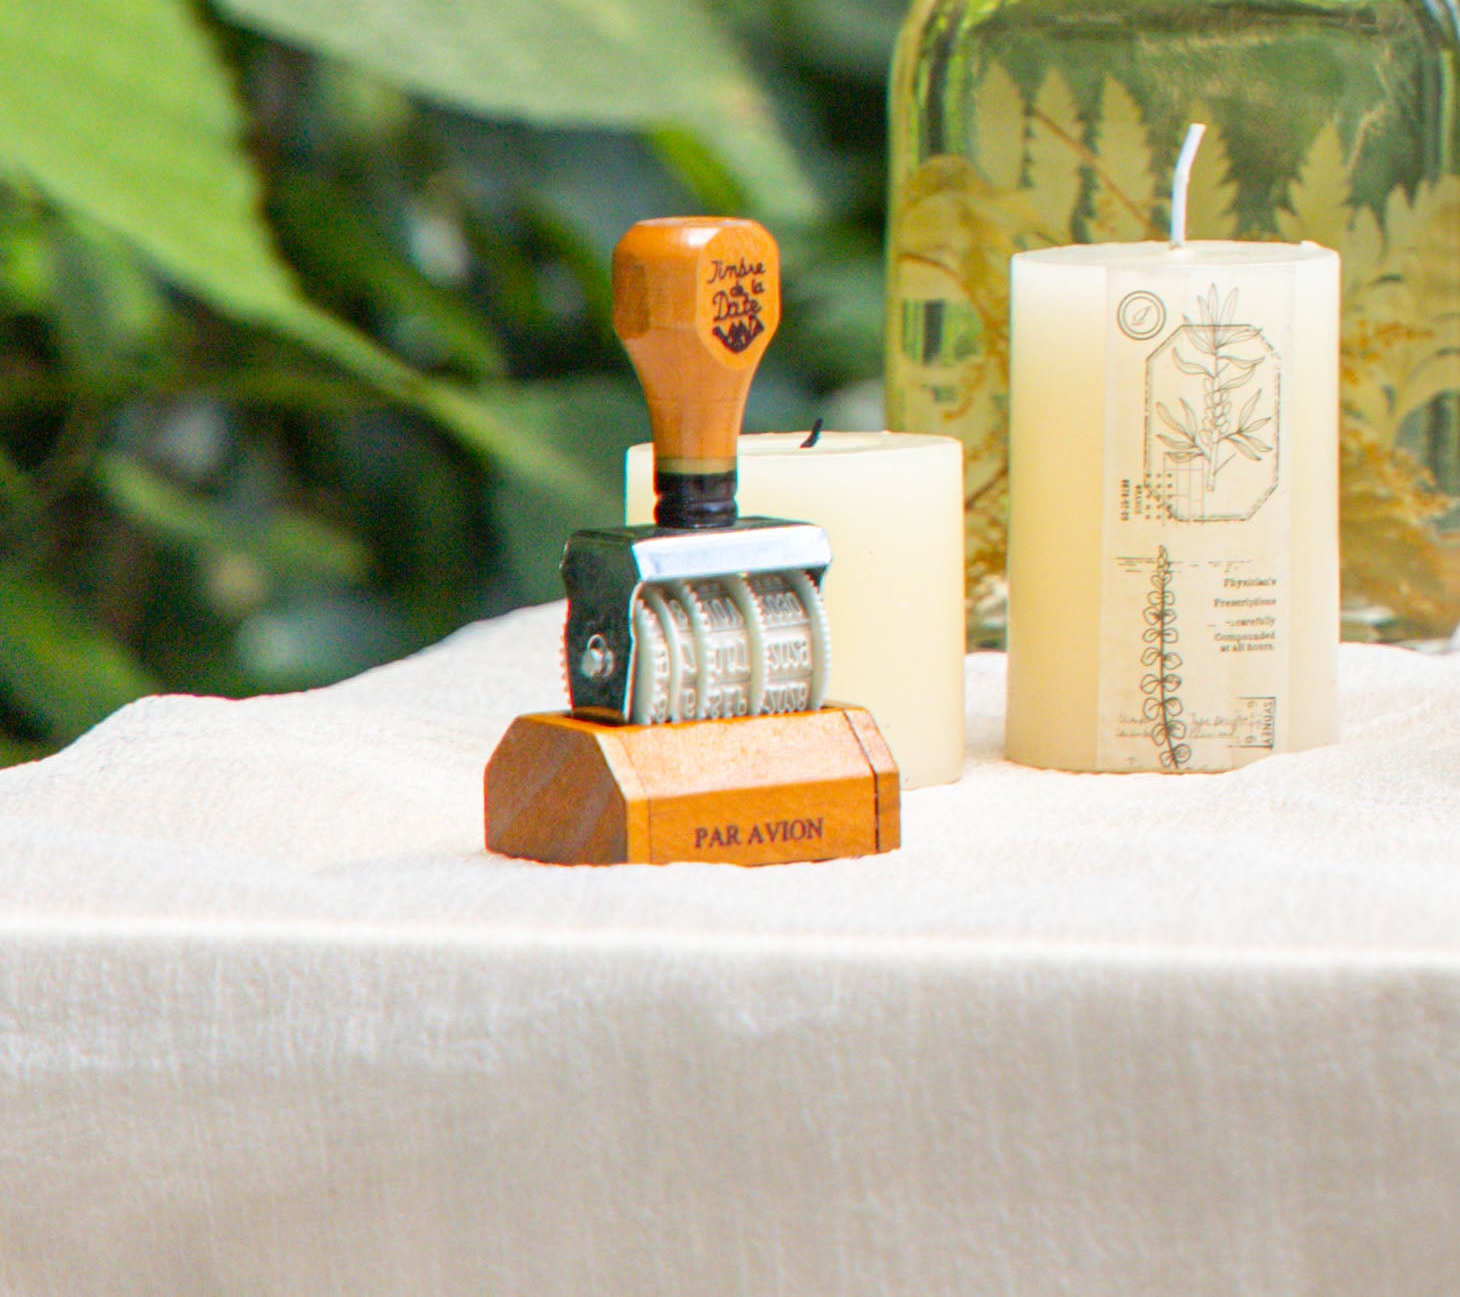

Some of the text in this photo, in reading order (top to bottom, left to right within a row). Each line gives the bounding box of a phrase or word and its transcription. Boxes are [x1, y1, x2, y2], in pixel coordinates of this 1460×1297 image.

[712, 290, 762, 322] Date
[694, 817, 824, 848] PAR AVION
